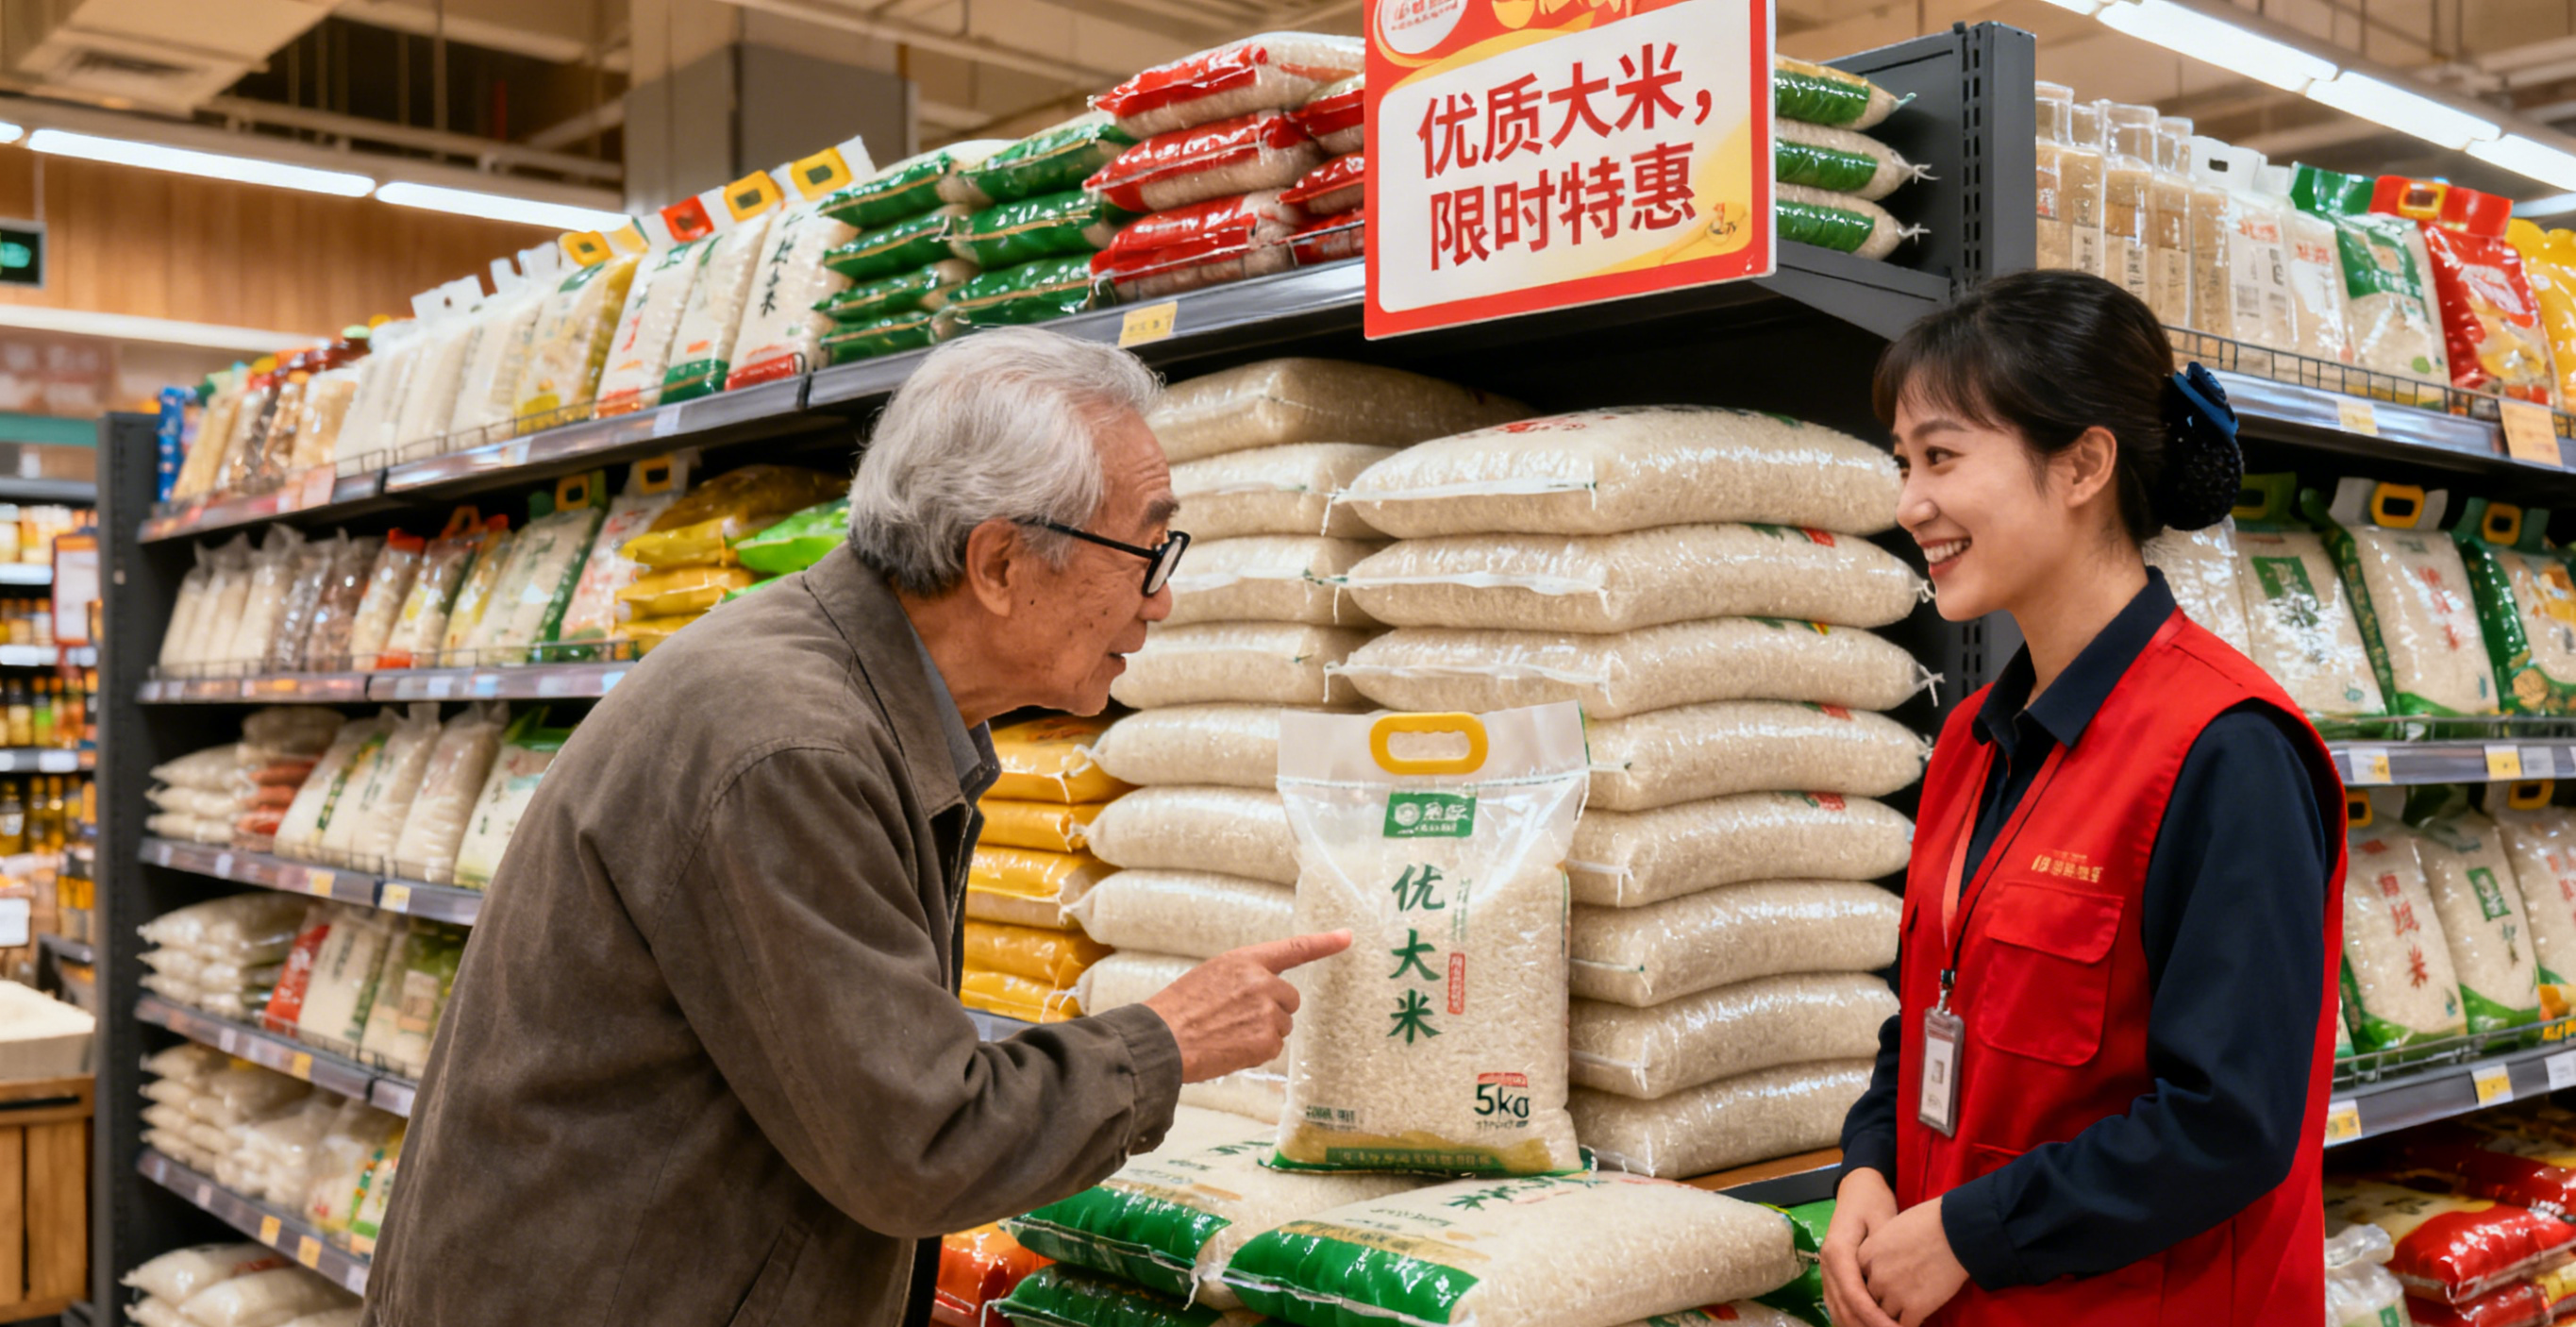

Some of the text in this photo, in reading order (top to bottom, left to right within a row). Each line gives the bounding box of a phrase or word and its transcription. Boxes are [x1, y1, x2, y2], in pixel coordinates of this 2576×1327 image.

[1430, 142, 1697, 271] 限时特惠
[1386, 863, 1447, 1046] 优大米
